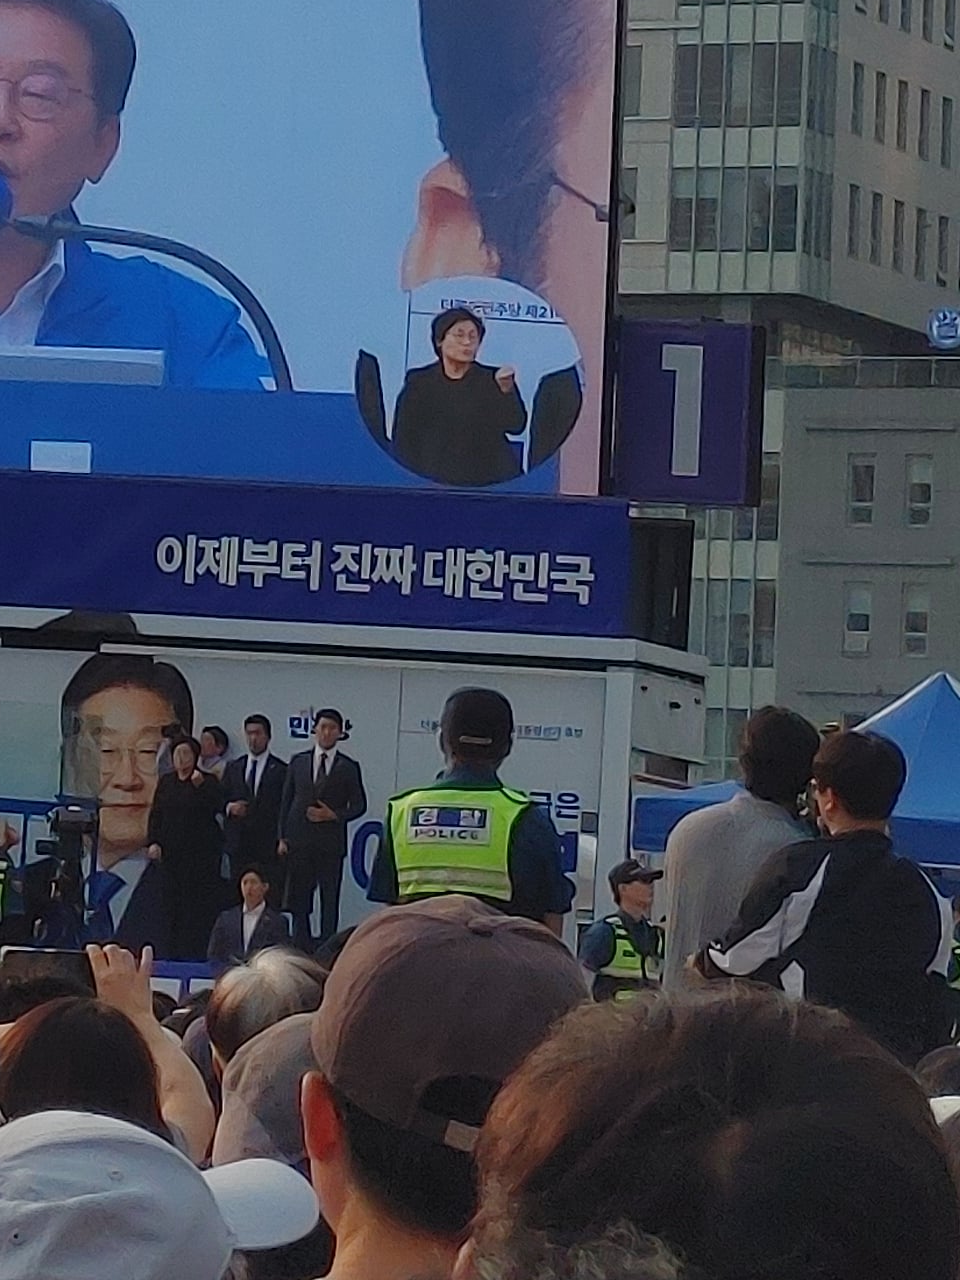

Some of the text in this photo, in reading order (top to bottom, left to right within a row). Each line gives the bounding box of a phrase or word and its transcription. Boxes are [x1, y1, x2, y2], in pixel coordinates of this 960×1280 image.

[661, 343, 704, 477] 1
[155, 533, 596, 606] 이제부터 진짜 대한민국
[414, 829, 479, 840] POLICE
